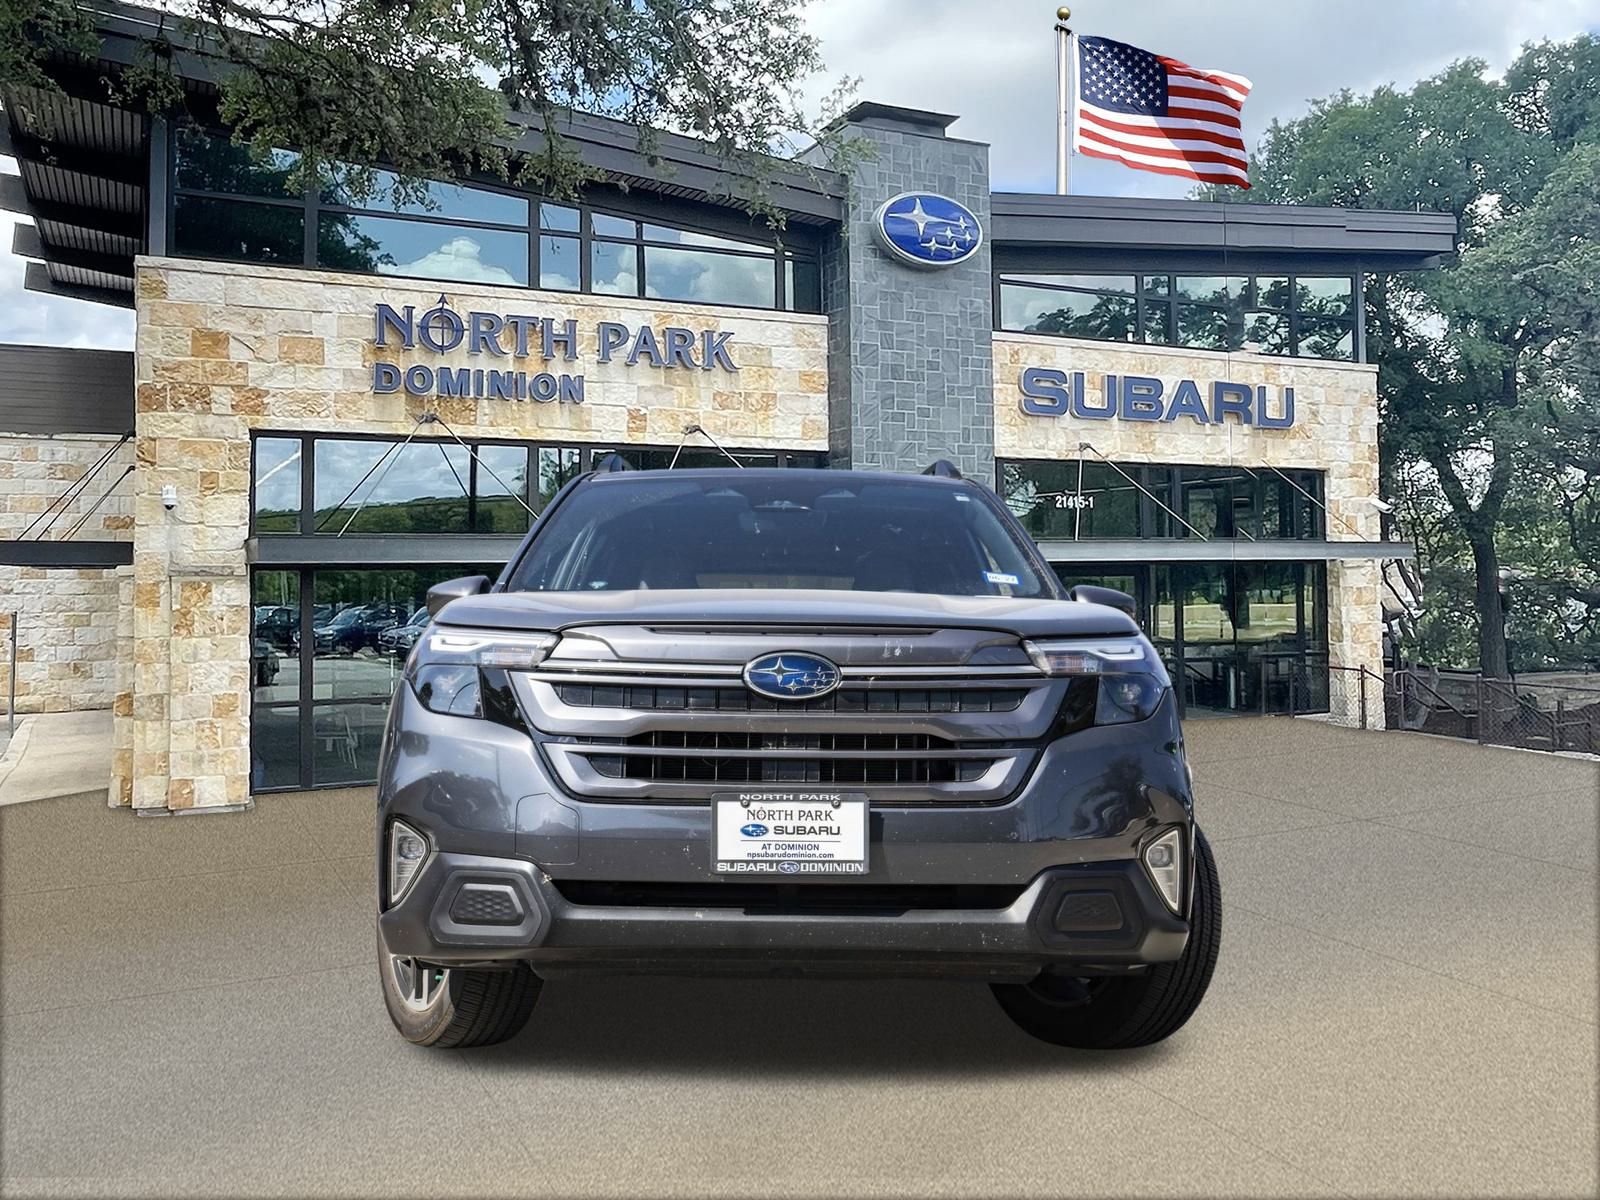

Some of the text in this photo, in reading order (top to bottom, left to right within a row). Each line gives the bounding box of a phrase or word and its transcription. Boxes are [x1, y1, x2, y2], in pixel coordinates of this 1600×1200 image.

[374, 294, 740, 373] NORTH PARK
[373, 362, 585, 405] DOMINION
[1019, 367, 1295, 429] SUBARU
[746, 807, 834, 821] NORTH PARK
[773, 825, 841, 835] SUBARU
[761, 843, 819, 851] AT DOMINION
[746, 851, 835, 859] npsubarudominion.com
[716, 862, 864, 872] SUBARU DOMINION
